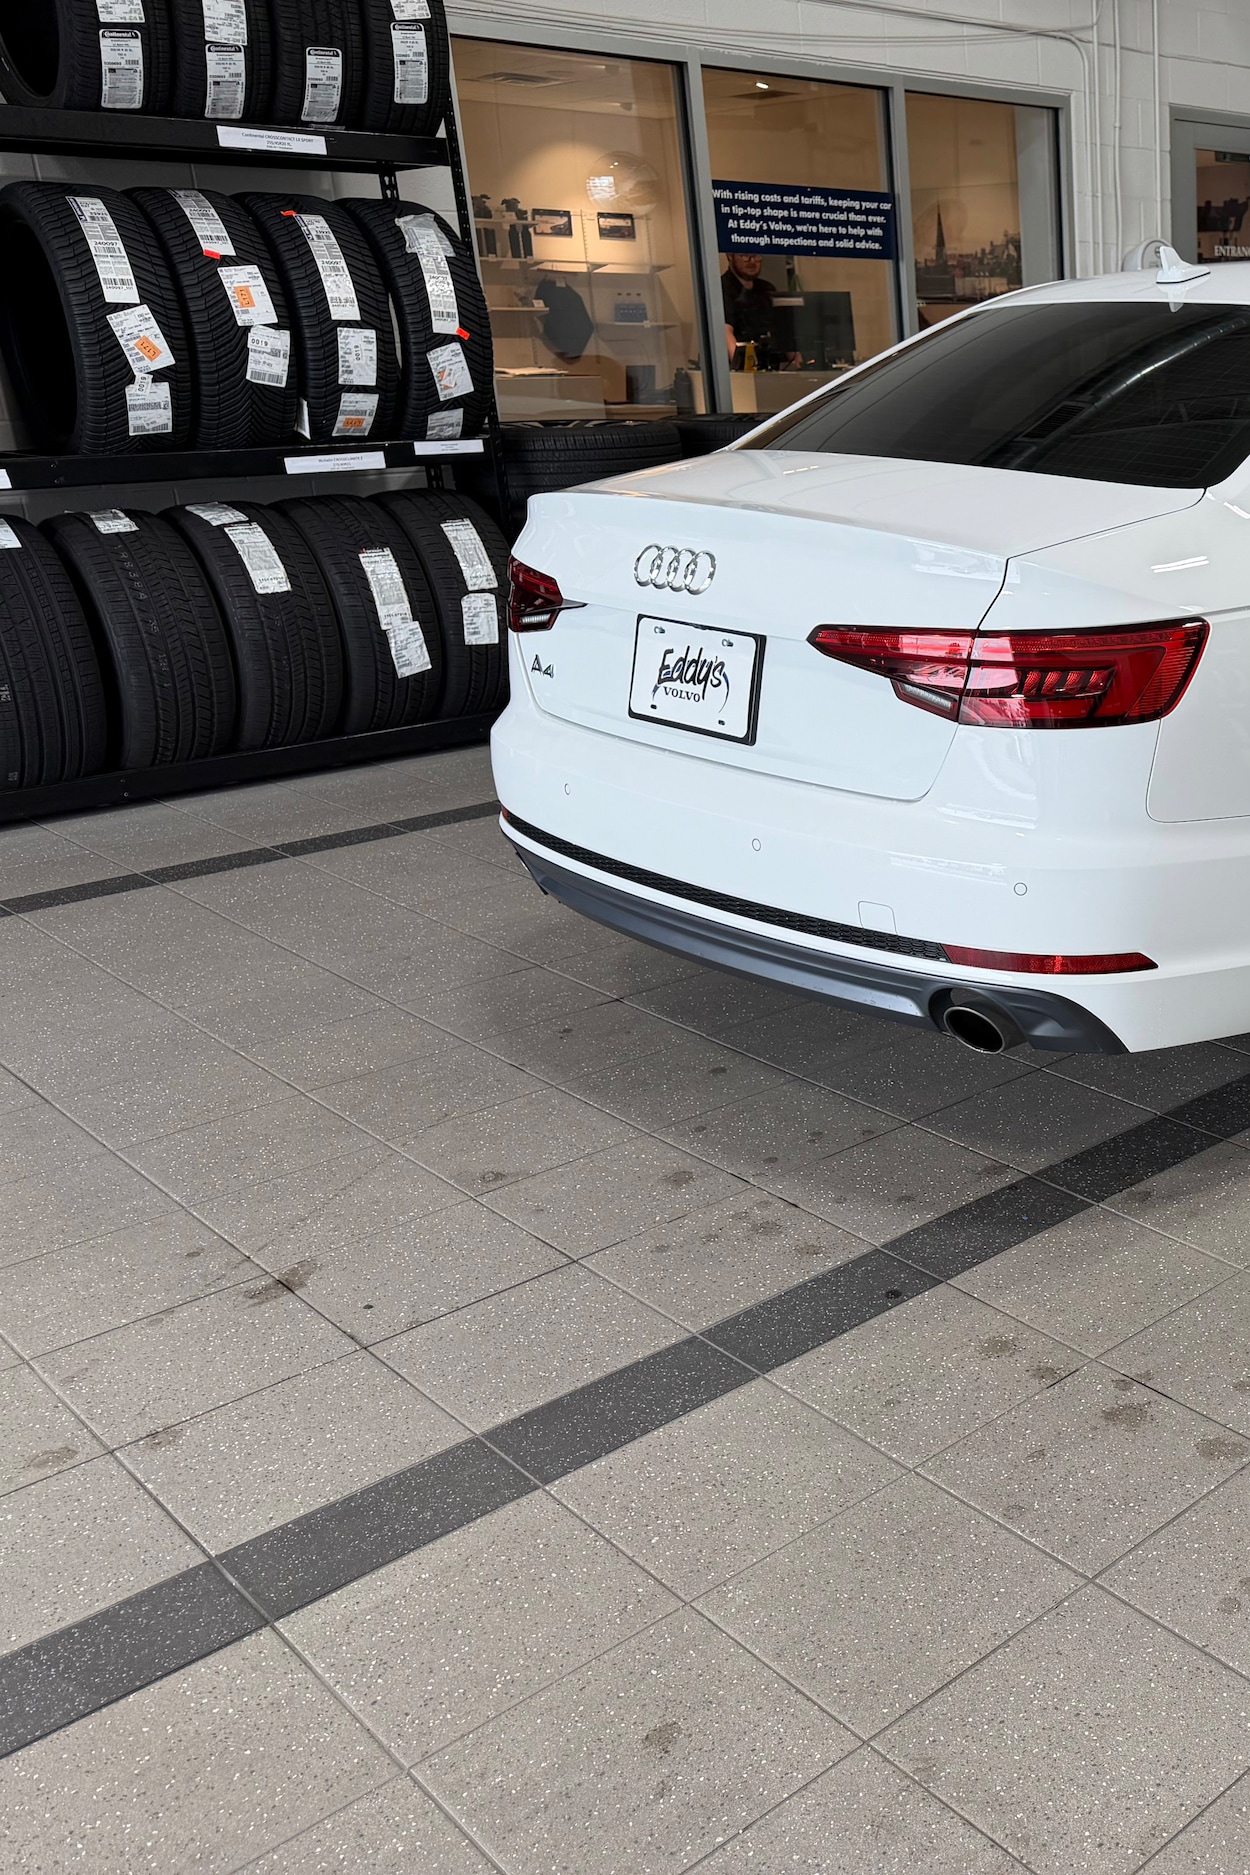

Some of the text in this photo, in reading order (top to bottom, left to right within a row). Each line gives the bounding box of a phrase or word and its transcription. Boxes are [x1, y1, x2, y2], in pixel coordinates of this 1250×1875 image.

[712, 189, 733, 200] With
[734, 190, 759, 203] rising
[761, 194, 781, 202] costs
[783, 194, 800, 204] and
[801, 195, 827, 207] tariffs,
[828, 196, 860, 210] keeping
[861, 201, 879, 210] your
[721, 204, 886, 223] in tip-top shape is more crucial than ever.
[728, 219, 883, 238] At Eddy's Volvo, we're here to help with
[731, 233, 882, 249] thorough inspections and solid advice.
[251, 338, 269, 347] 0019
[138, 376, 147, 392] 0019
[531, 654, 555, 679] A4
[657, 645, 726, 700] Eddy's
[663, 686, 701, 703] VOLVO
